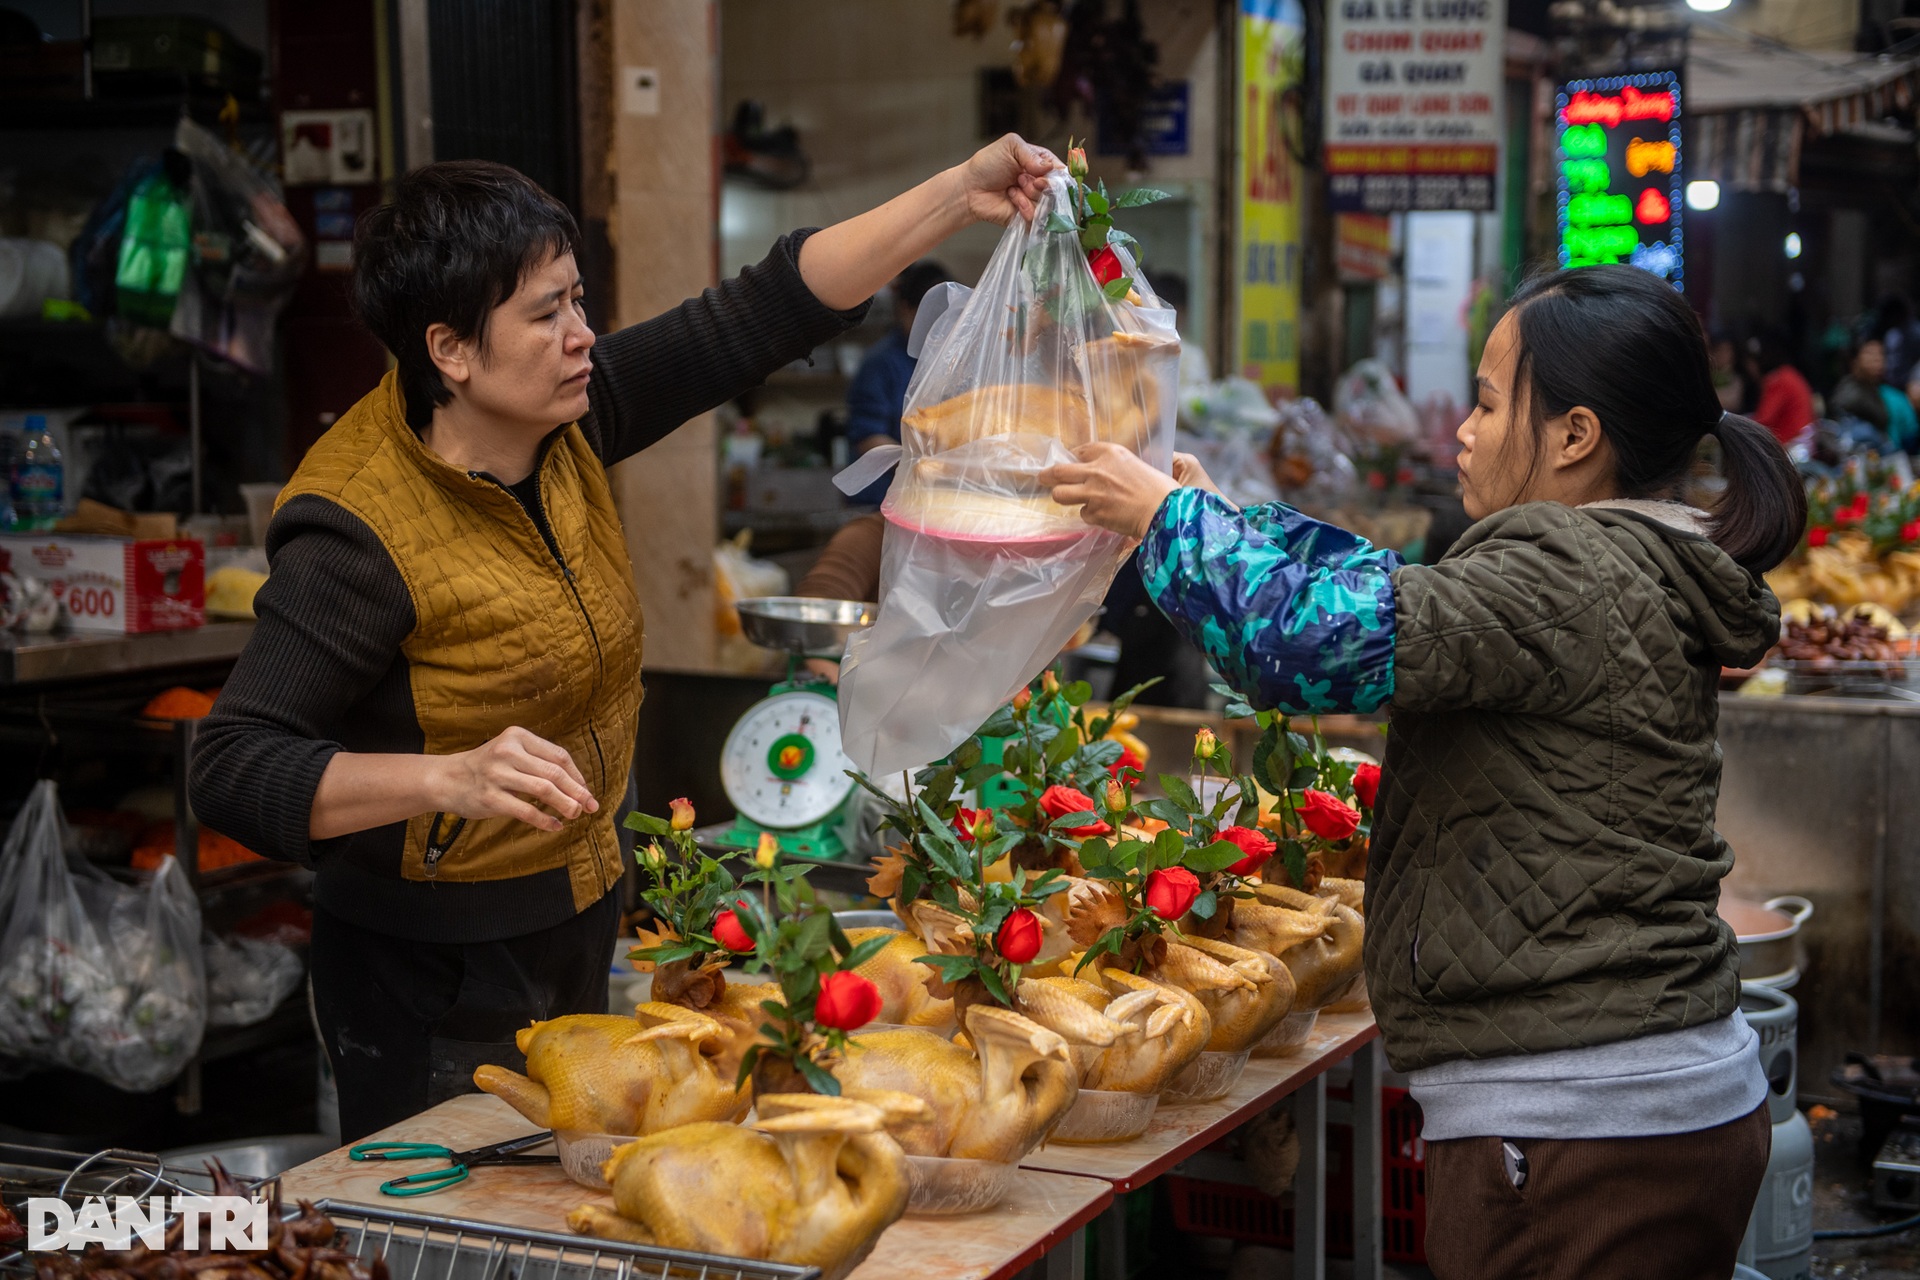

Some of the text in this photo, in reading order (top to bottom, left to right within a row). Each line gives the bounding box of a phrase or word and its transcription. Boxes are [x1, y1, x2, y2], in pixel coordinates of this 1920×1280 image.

[1344, 31, 1484, 54] CHIM QUAY
[1404, 62, 1466, 85] QUAY
[69, 587, 115, 617] 600
